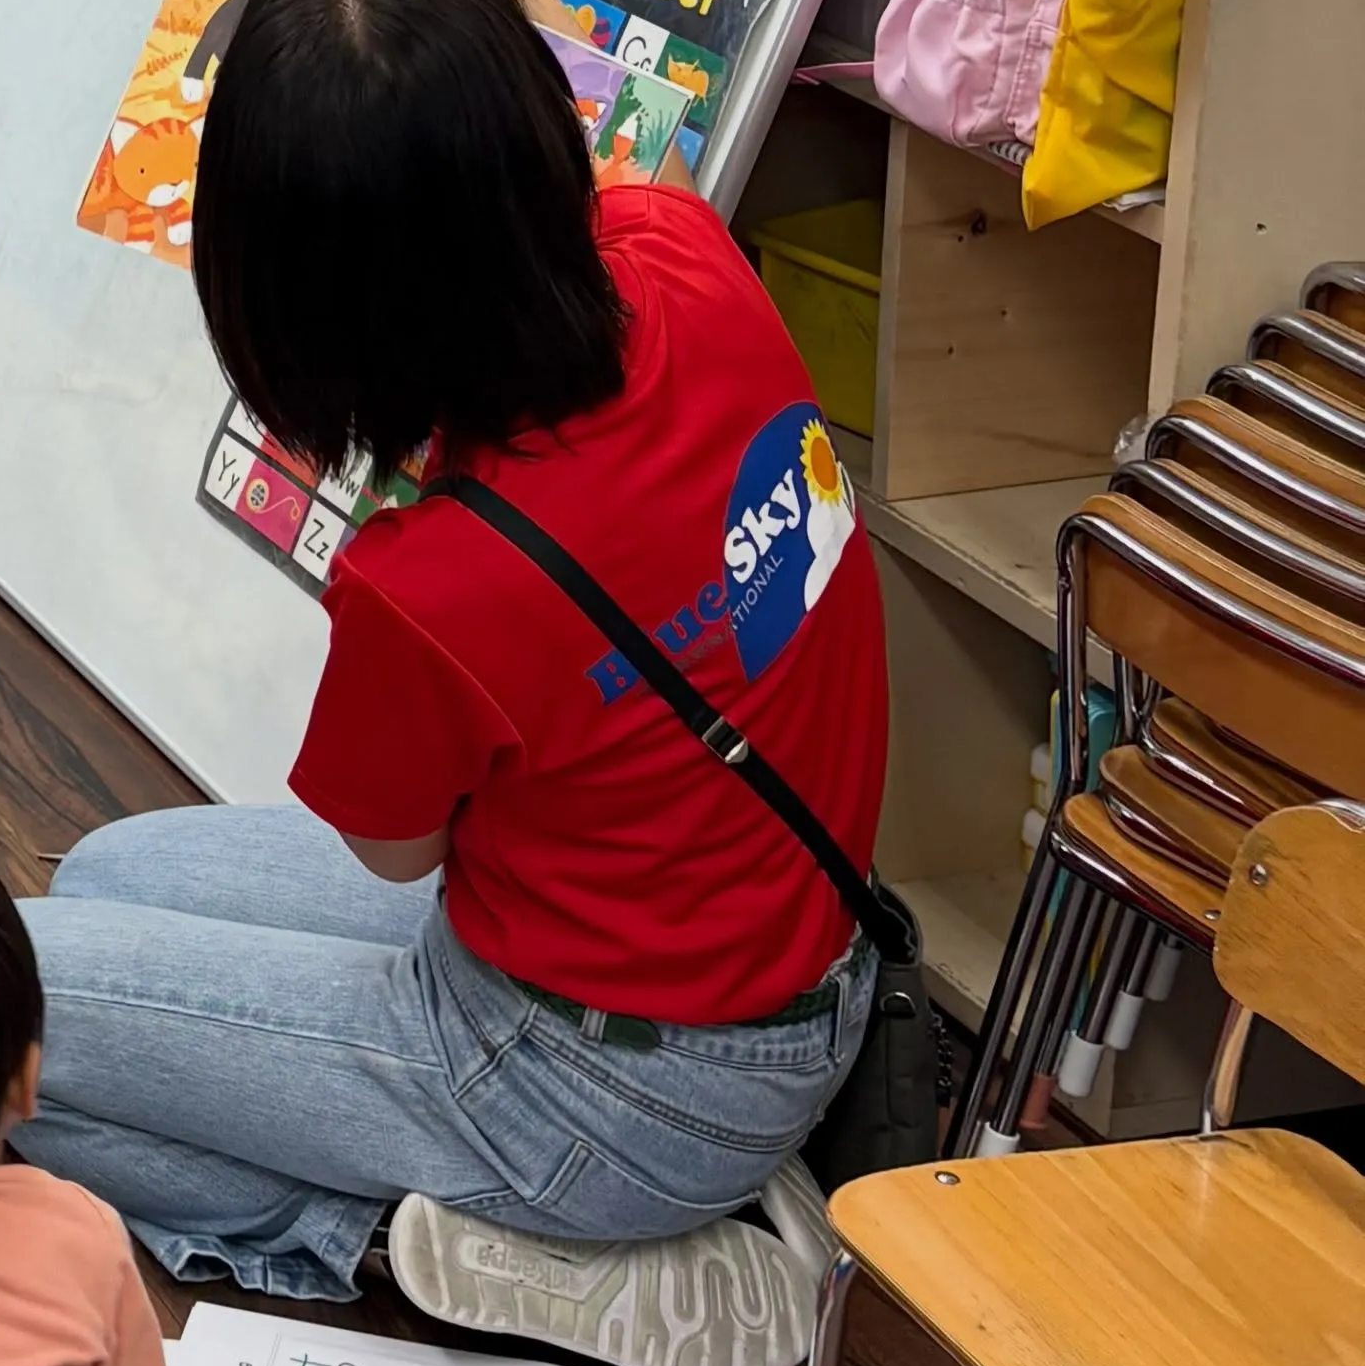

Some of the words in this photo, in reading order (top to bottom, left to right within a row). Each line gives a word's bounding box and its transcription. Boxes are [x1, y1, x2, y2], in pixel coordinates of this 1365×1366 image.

[218, 450, 241, 501] Yy
[303, 518, 330, 562] Zz
[584, 580, 728, 706] Bue
[724, 468, 801, 584] Sky
